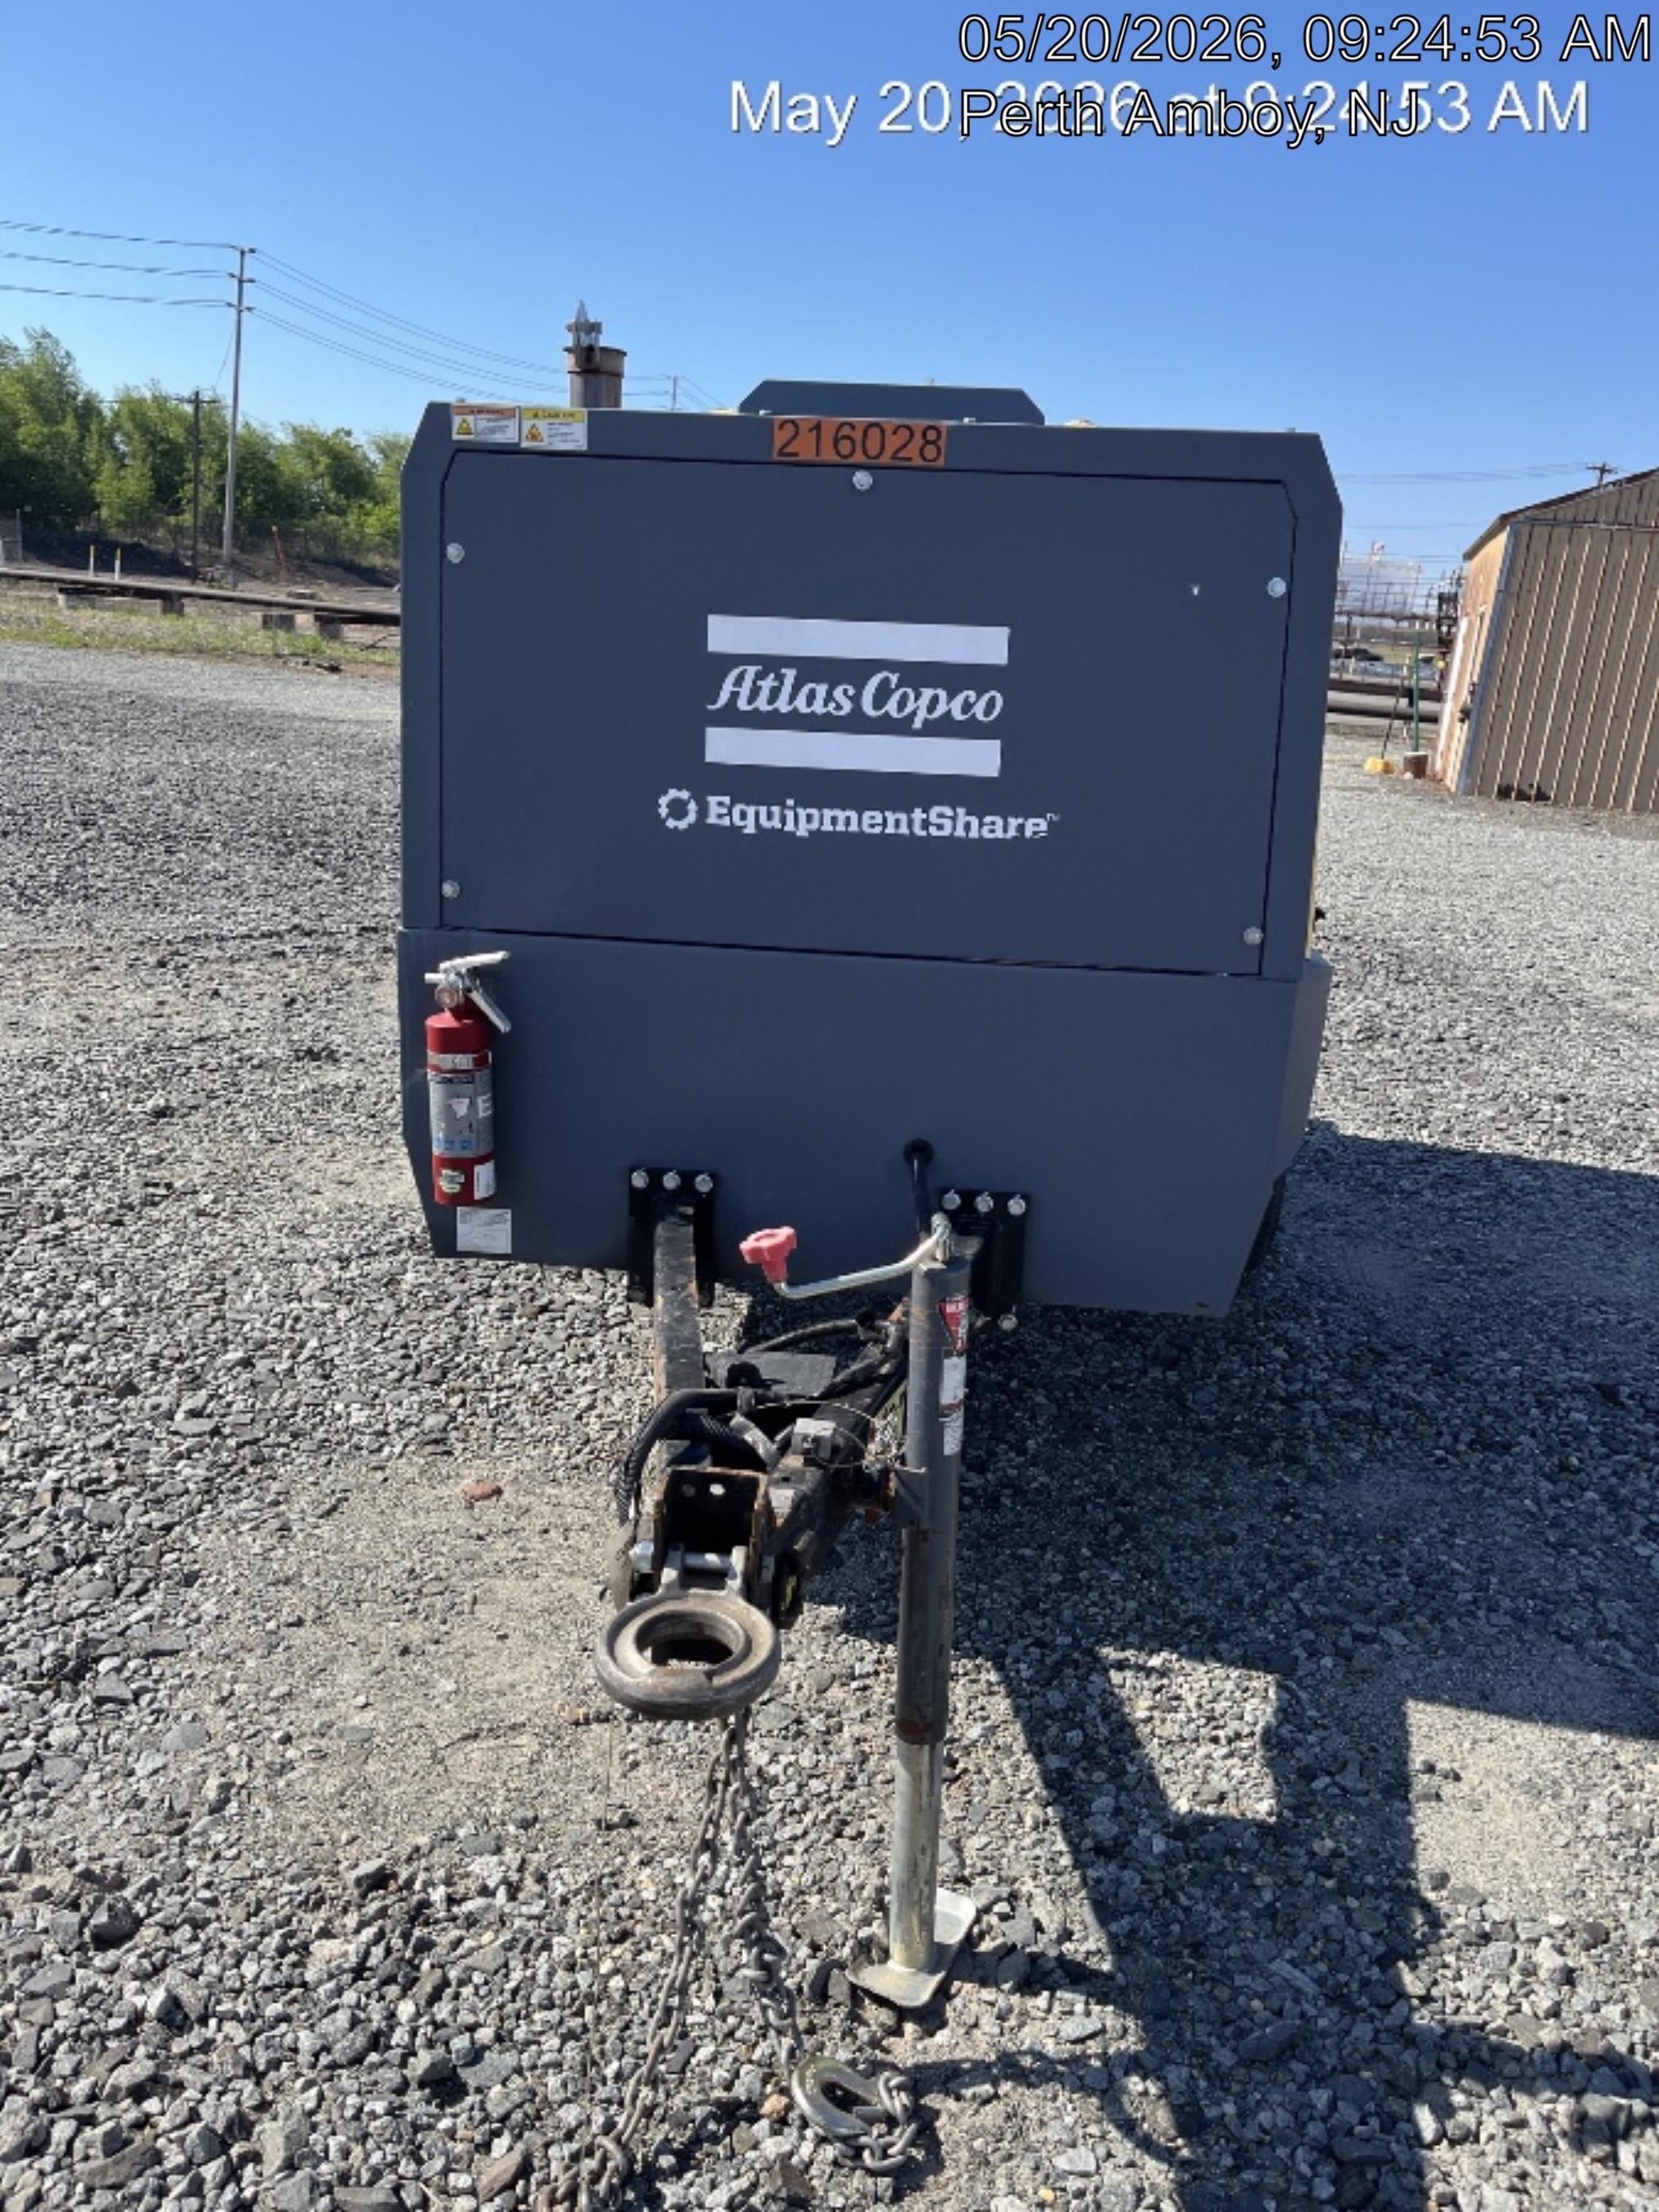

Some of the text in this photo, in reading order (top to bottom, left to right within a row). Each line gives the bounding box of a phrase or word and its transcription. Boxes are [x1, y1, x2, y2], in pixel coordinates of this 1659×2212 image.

[776, 419, 943, 464] 216028
[706, 664, 1004, 731] Atlas Copco
[705, 795, 1049, 840] EquipmentShare
